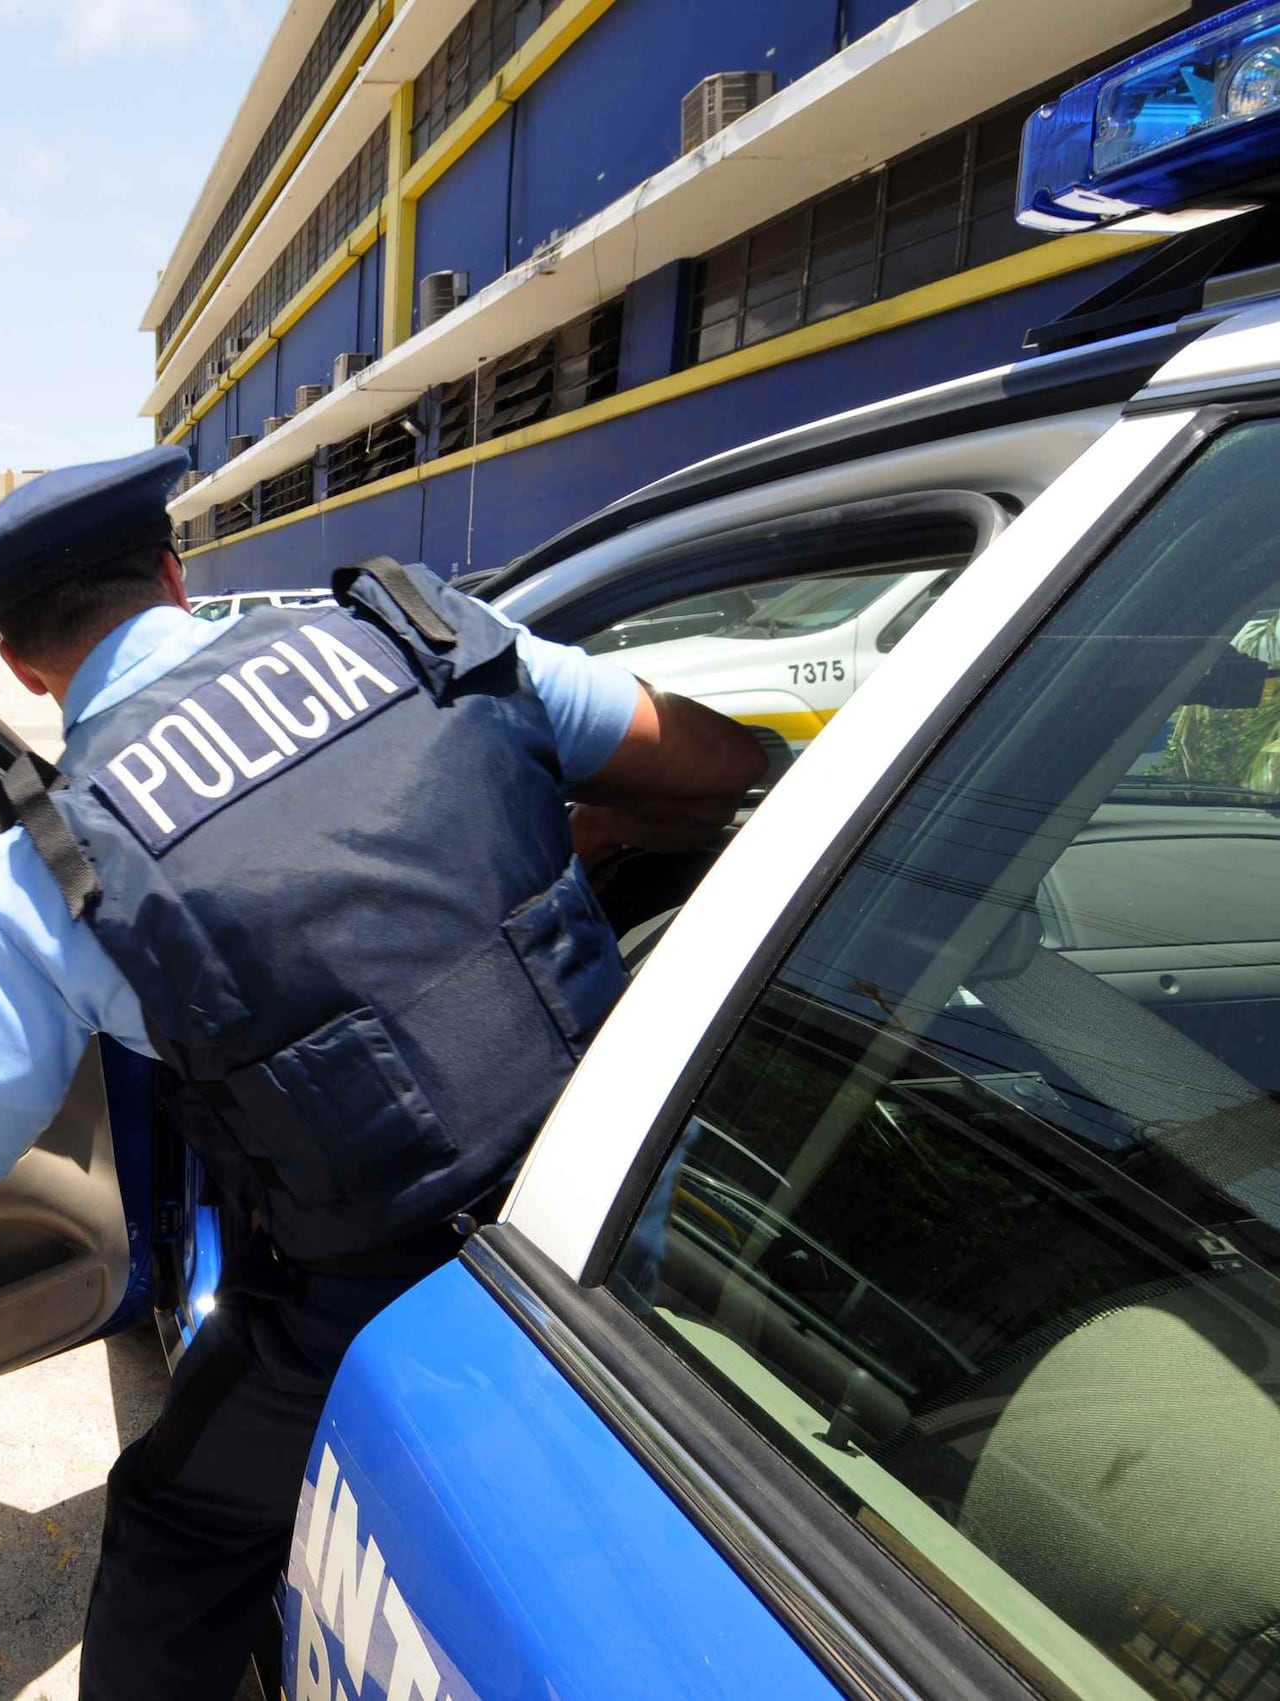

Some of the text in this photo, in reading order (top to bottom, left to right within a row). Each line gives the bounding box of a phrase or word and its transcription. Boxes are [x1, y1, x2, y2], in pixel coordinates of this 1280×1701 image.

[106, 624, 399, 834] POLICIA
[788, 659, 845, 685] 7375
[305, 1442, 453, 1701] INT
